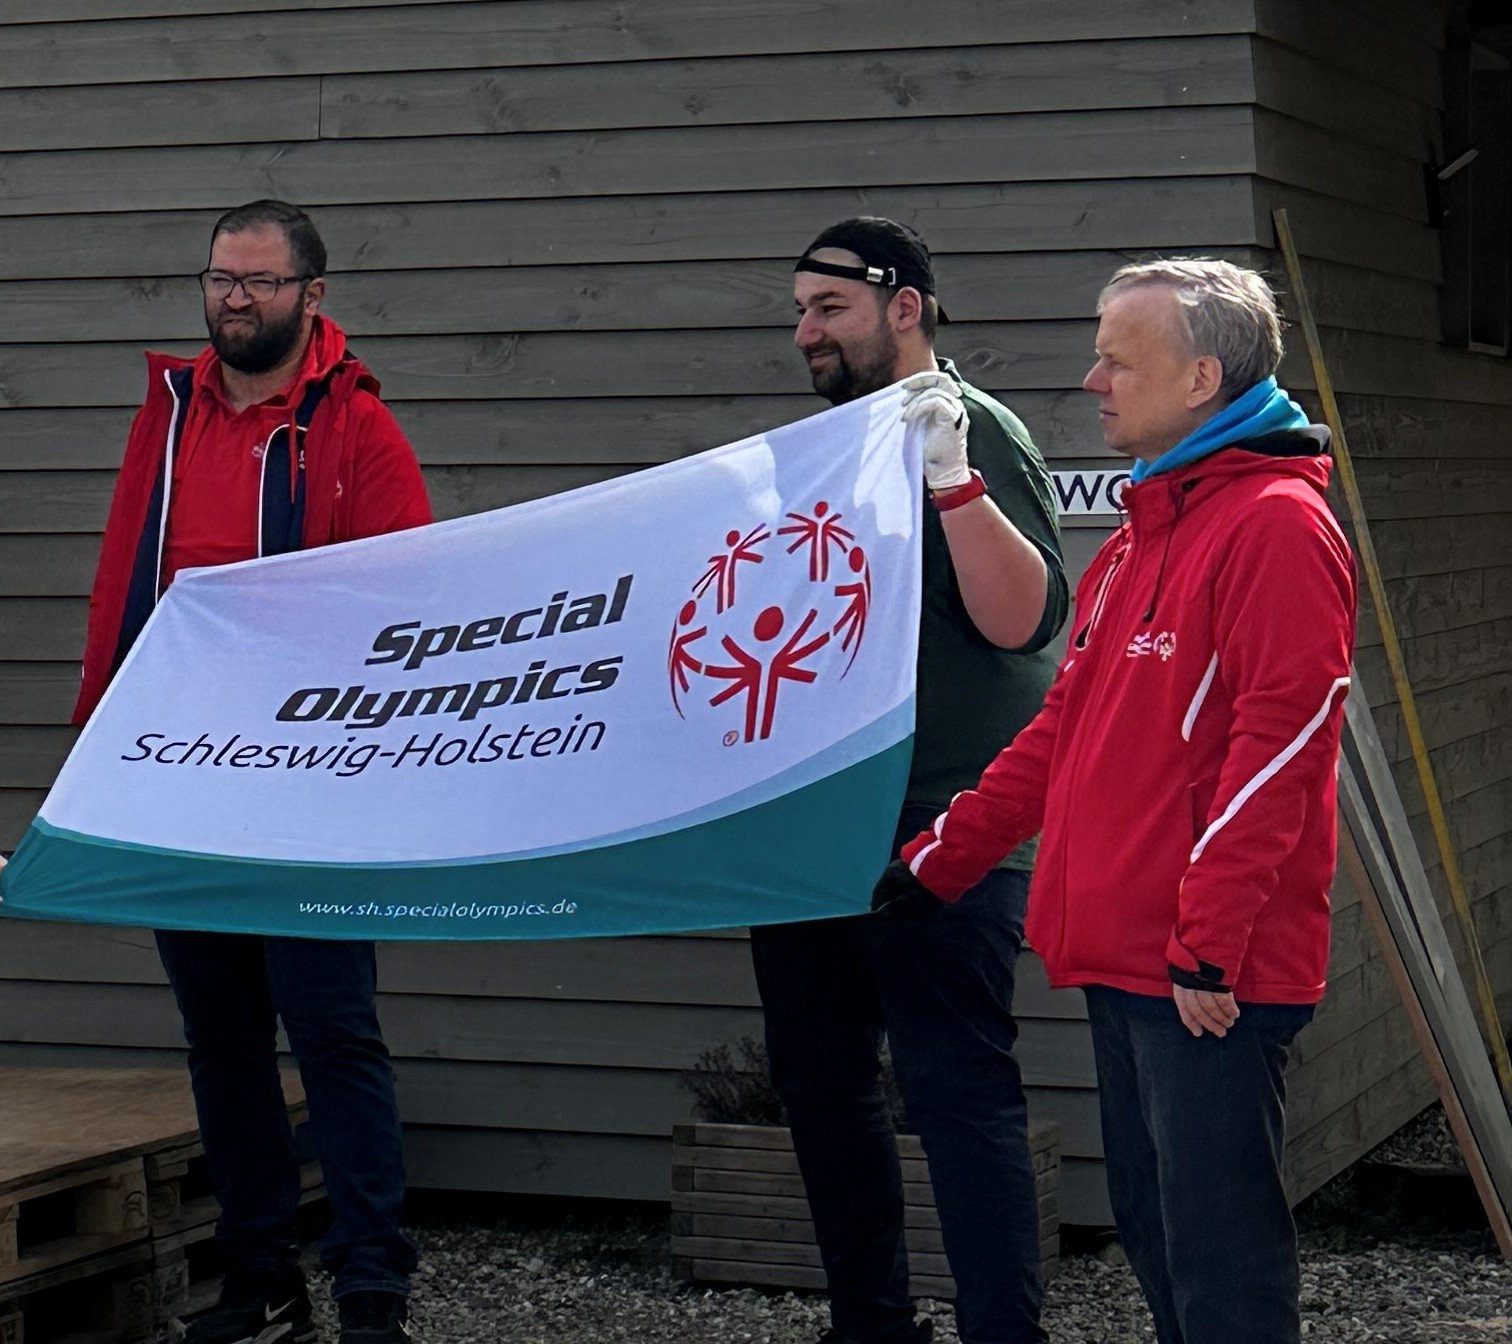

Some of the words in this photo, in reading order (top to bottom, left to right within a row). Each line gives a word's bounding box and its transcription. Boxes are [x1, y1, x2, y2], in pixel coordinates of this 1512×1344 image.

[364, 574, 634, 670] Special
[275, 655, 624, 729] Olympics
[121, 713, 608, 777] Schleswig-Holstein
[298, 898, 578, 920] www.sh.specialolympics.de
